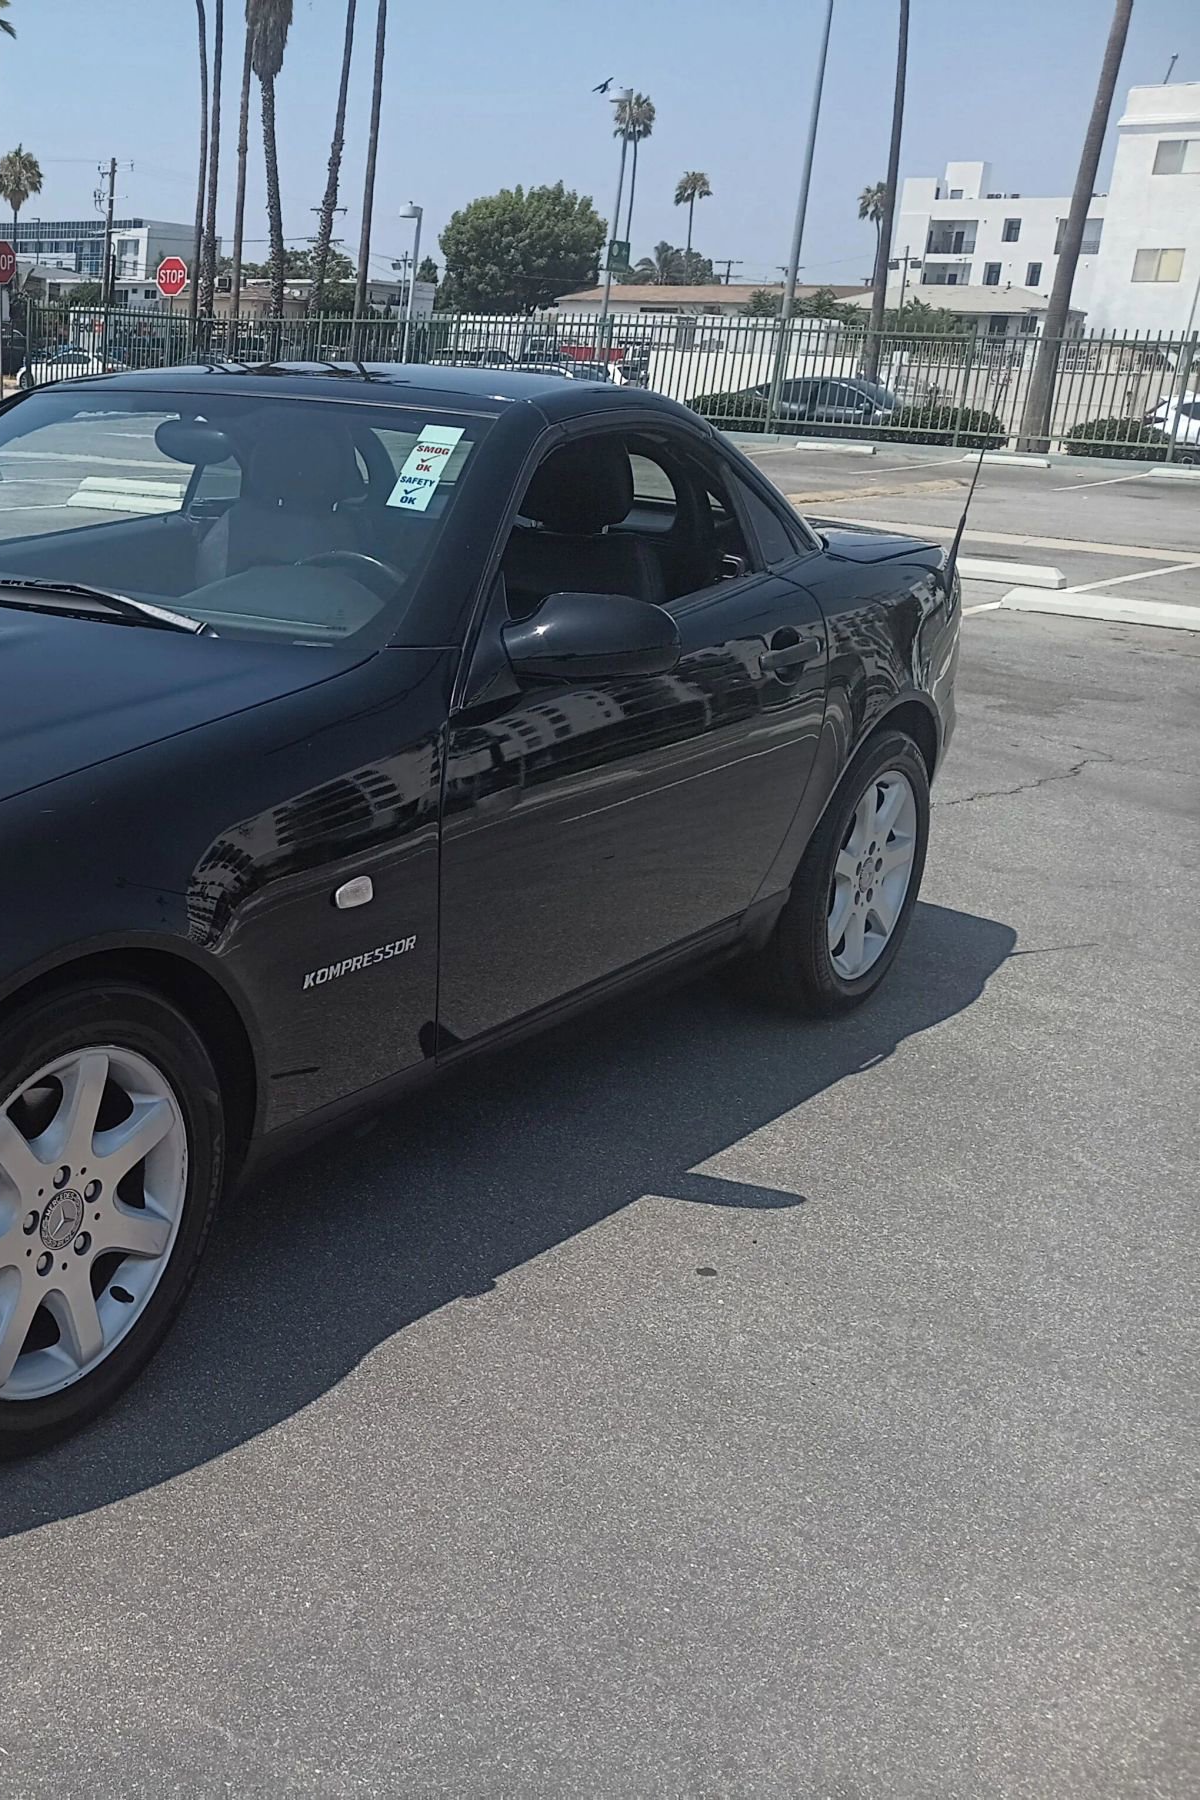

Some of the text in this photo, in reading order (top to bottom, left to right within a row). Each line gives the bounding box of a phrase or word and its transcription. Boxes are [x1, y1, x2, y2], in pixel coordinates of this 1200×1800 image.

[159, 270, 185, 284] STOP
[417, 445, 450, 455] SMOG
[416, 463, 433, 472] OK
[400, 475, 435, 487] SAFETY
[400, 495, 417, 505] OK
[302, 935, 417, 990] KOMPRESSOR
